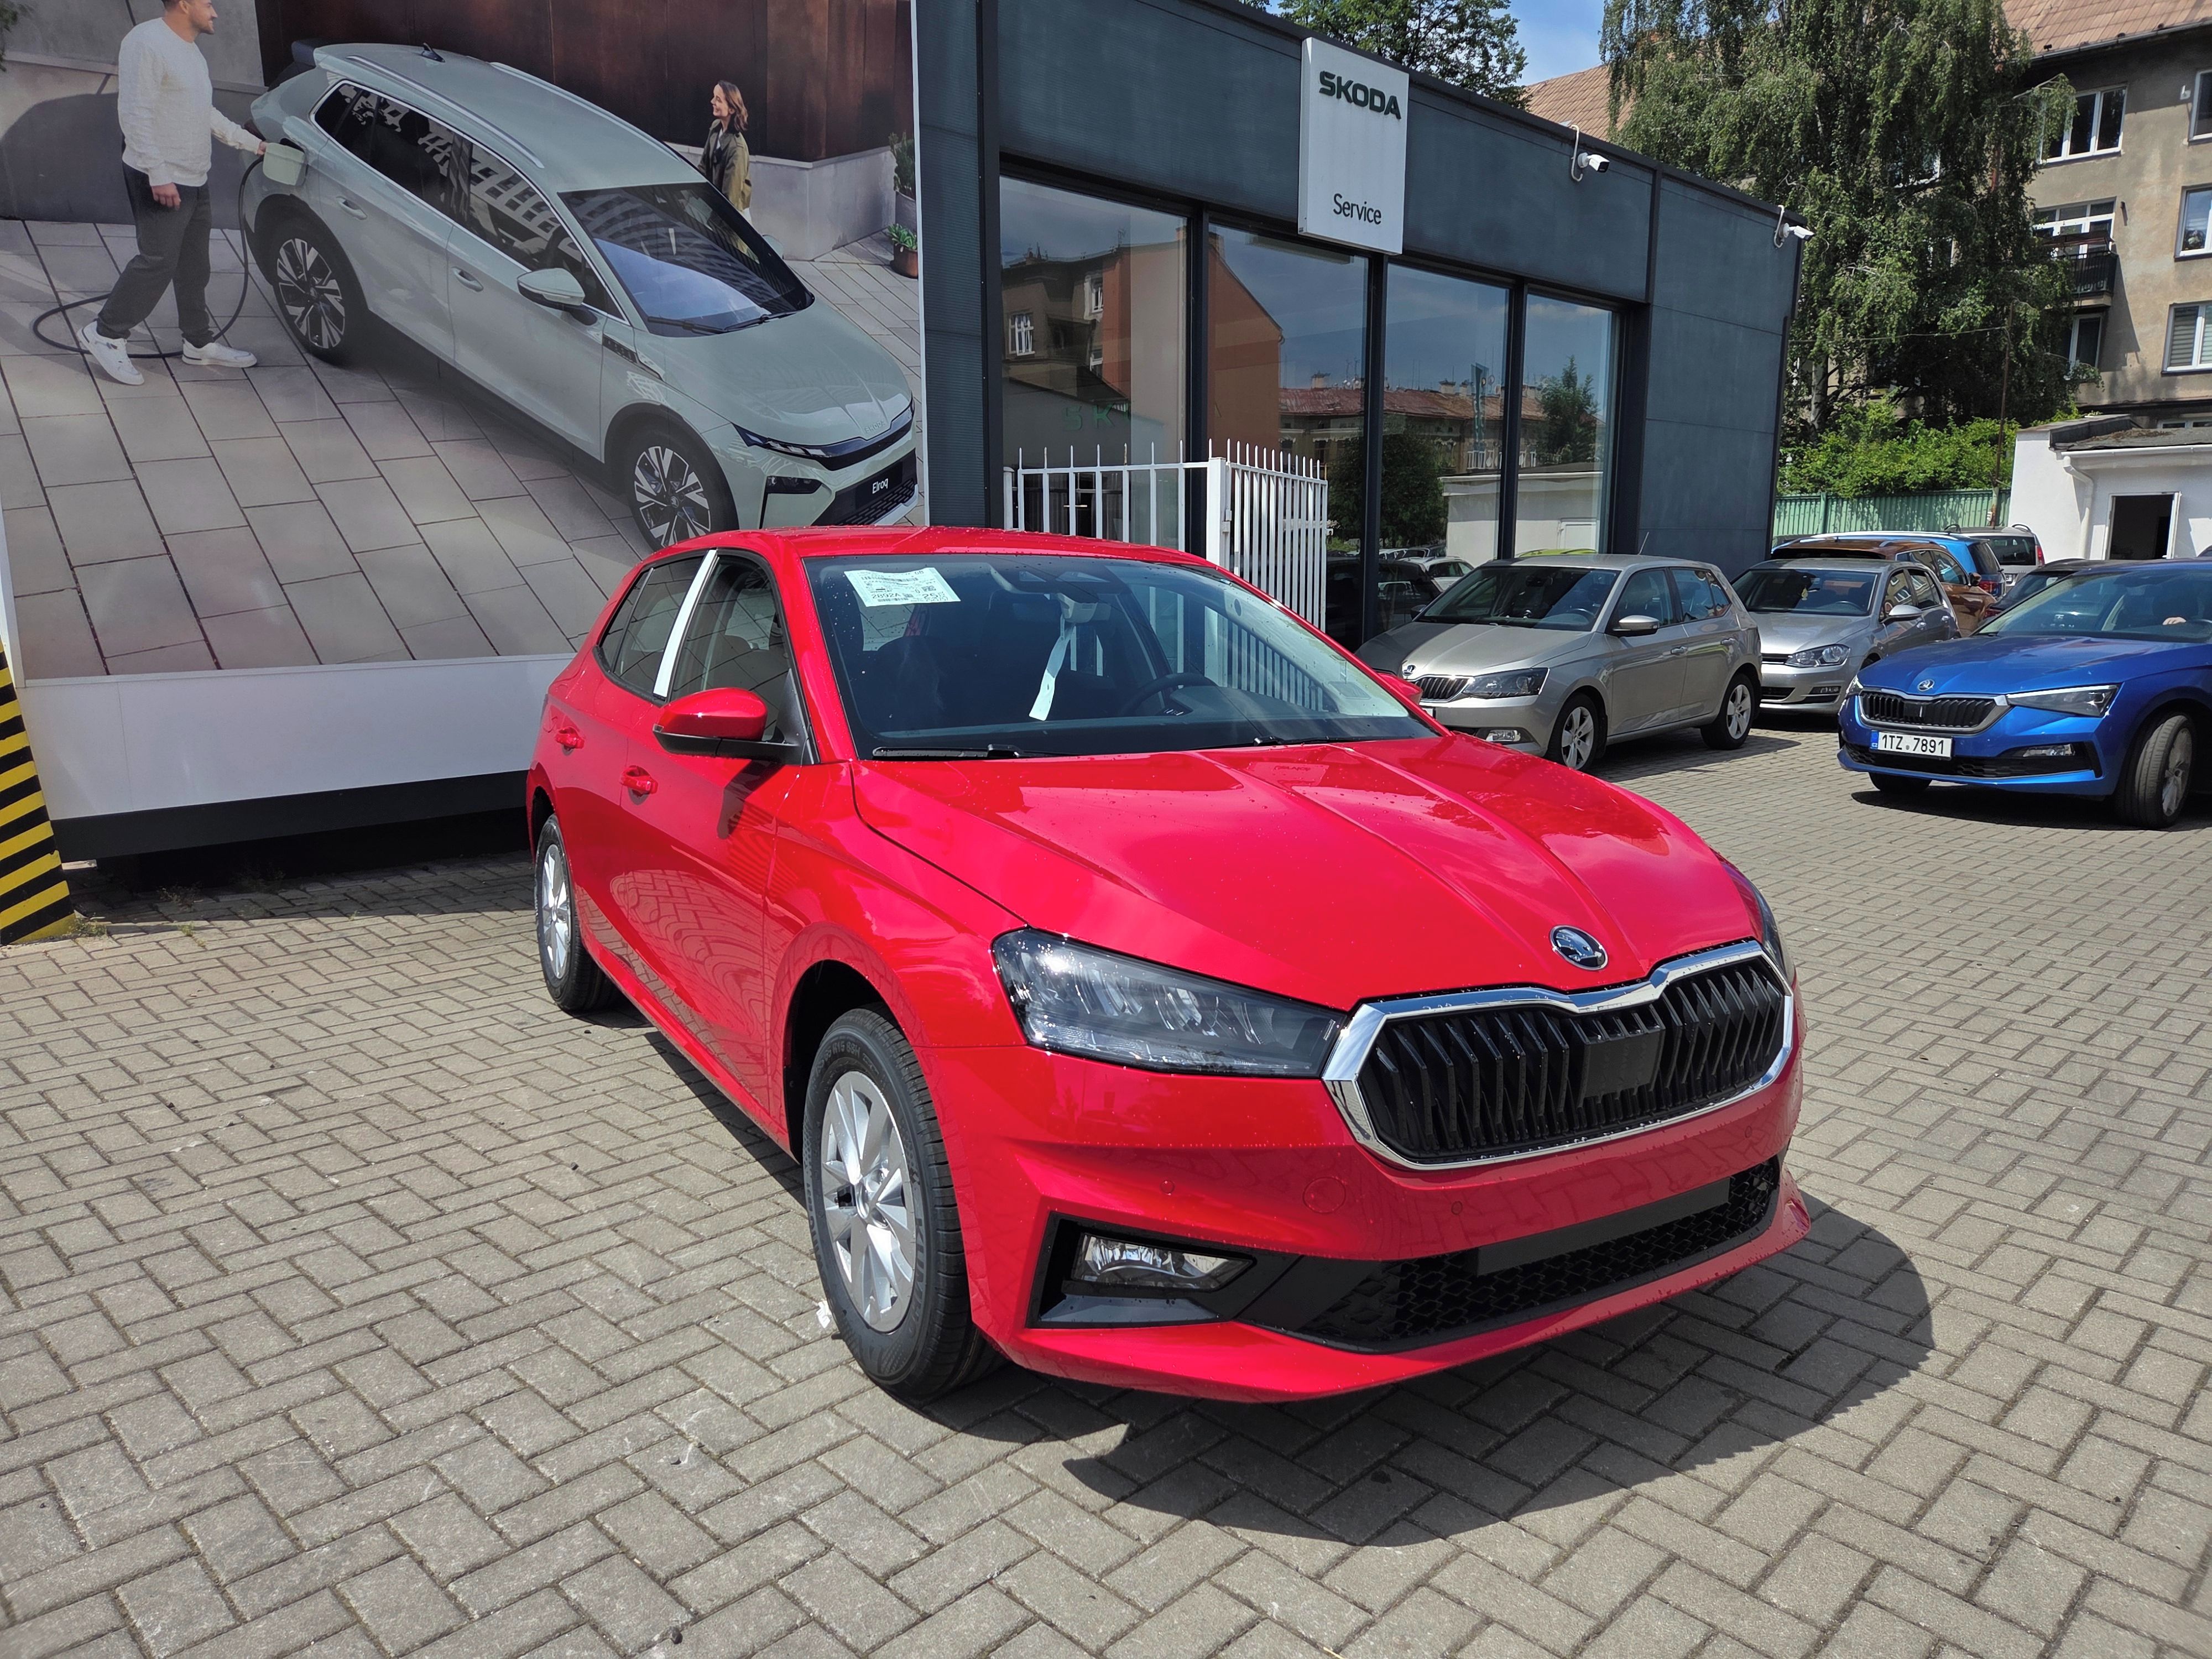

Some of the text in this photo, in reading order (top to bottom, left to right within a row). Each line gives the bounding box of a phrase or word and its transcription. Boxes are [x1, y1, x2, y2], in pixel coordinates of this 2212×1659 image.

[1333, 192, 1381, 225] Service
[872, 478, 889, 494] Elroq
[1882, 734, 1944, 754] 1TZ 7891
